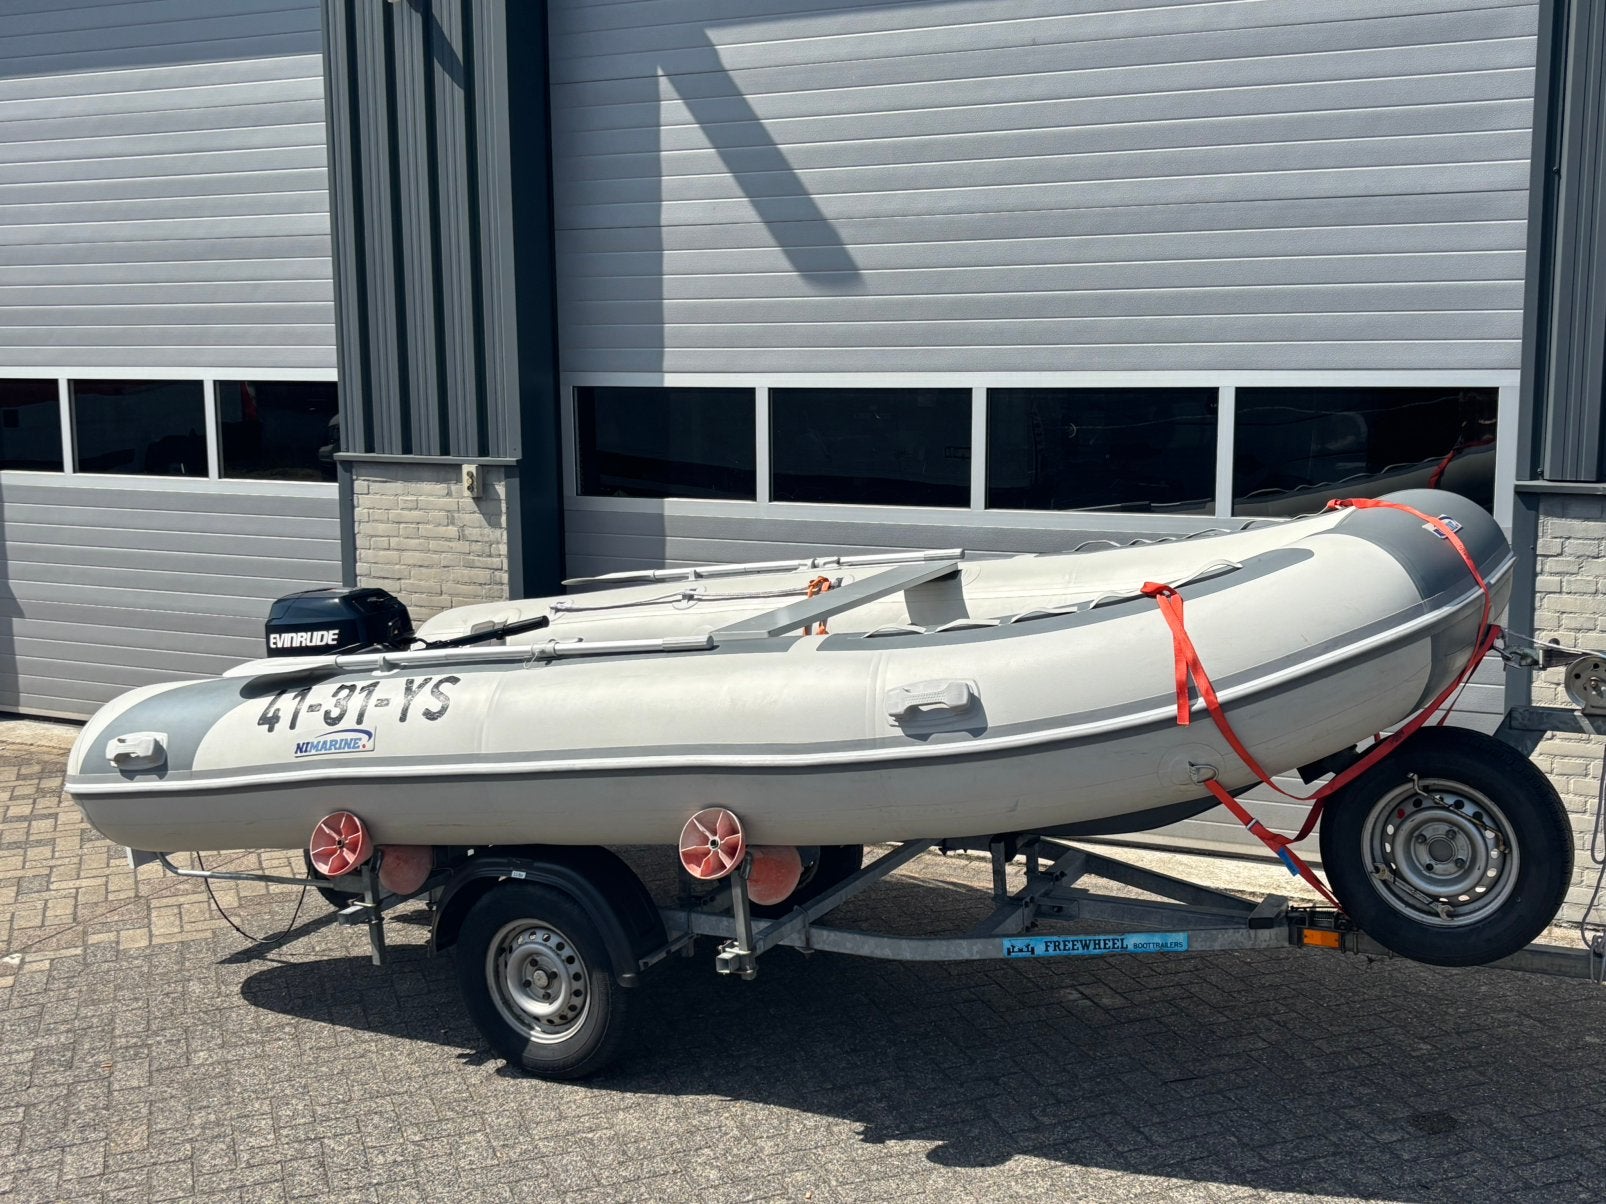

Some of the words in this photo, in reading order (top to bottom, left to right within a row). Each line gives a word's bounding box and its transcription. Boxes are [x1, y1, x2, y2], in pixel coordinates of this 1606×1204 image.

[269, 629, 339, 648] EVINRUDE
[257, 675, 461, 733] 41-31-YS
[1044, 938, 1128, 952] FREEWHEEL
[1133, 941, 1183, 950] BOOTTRAILERS
